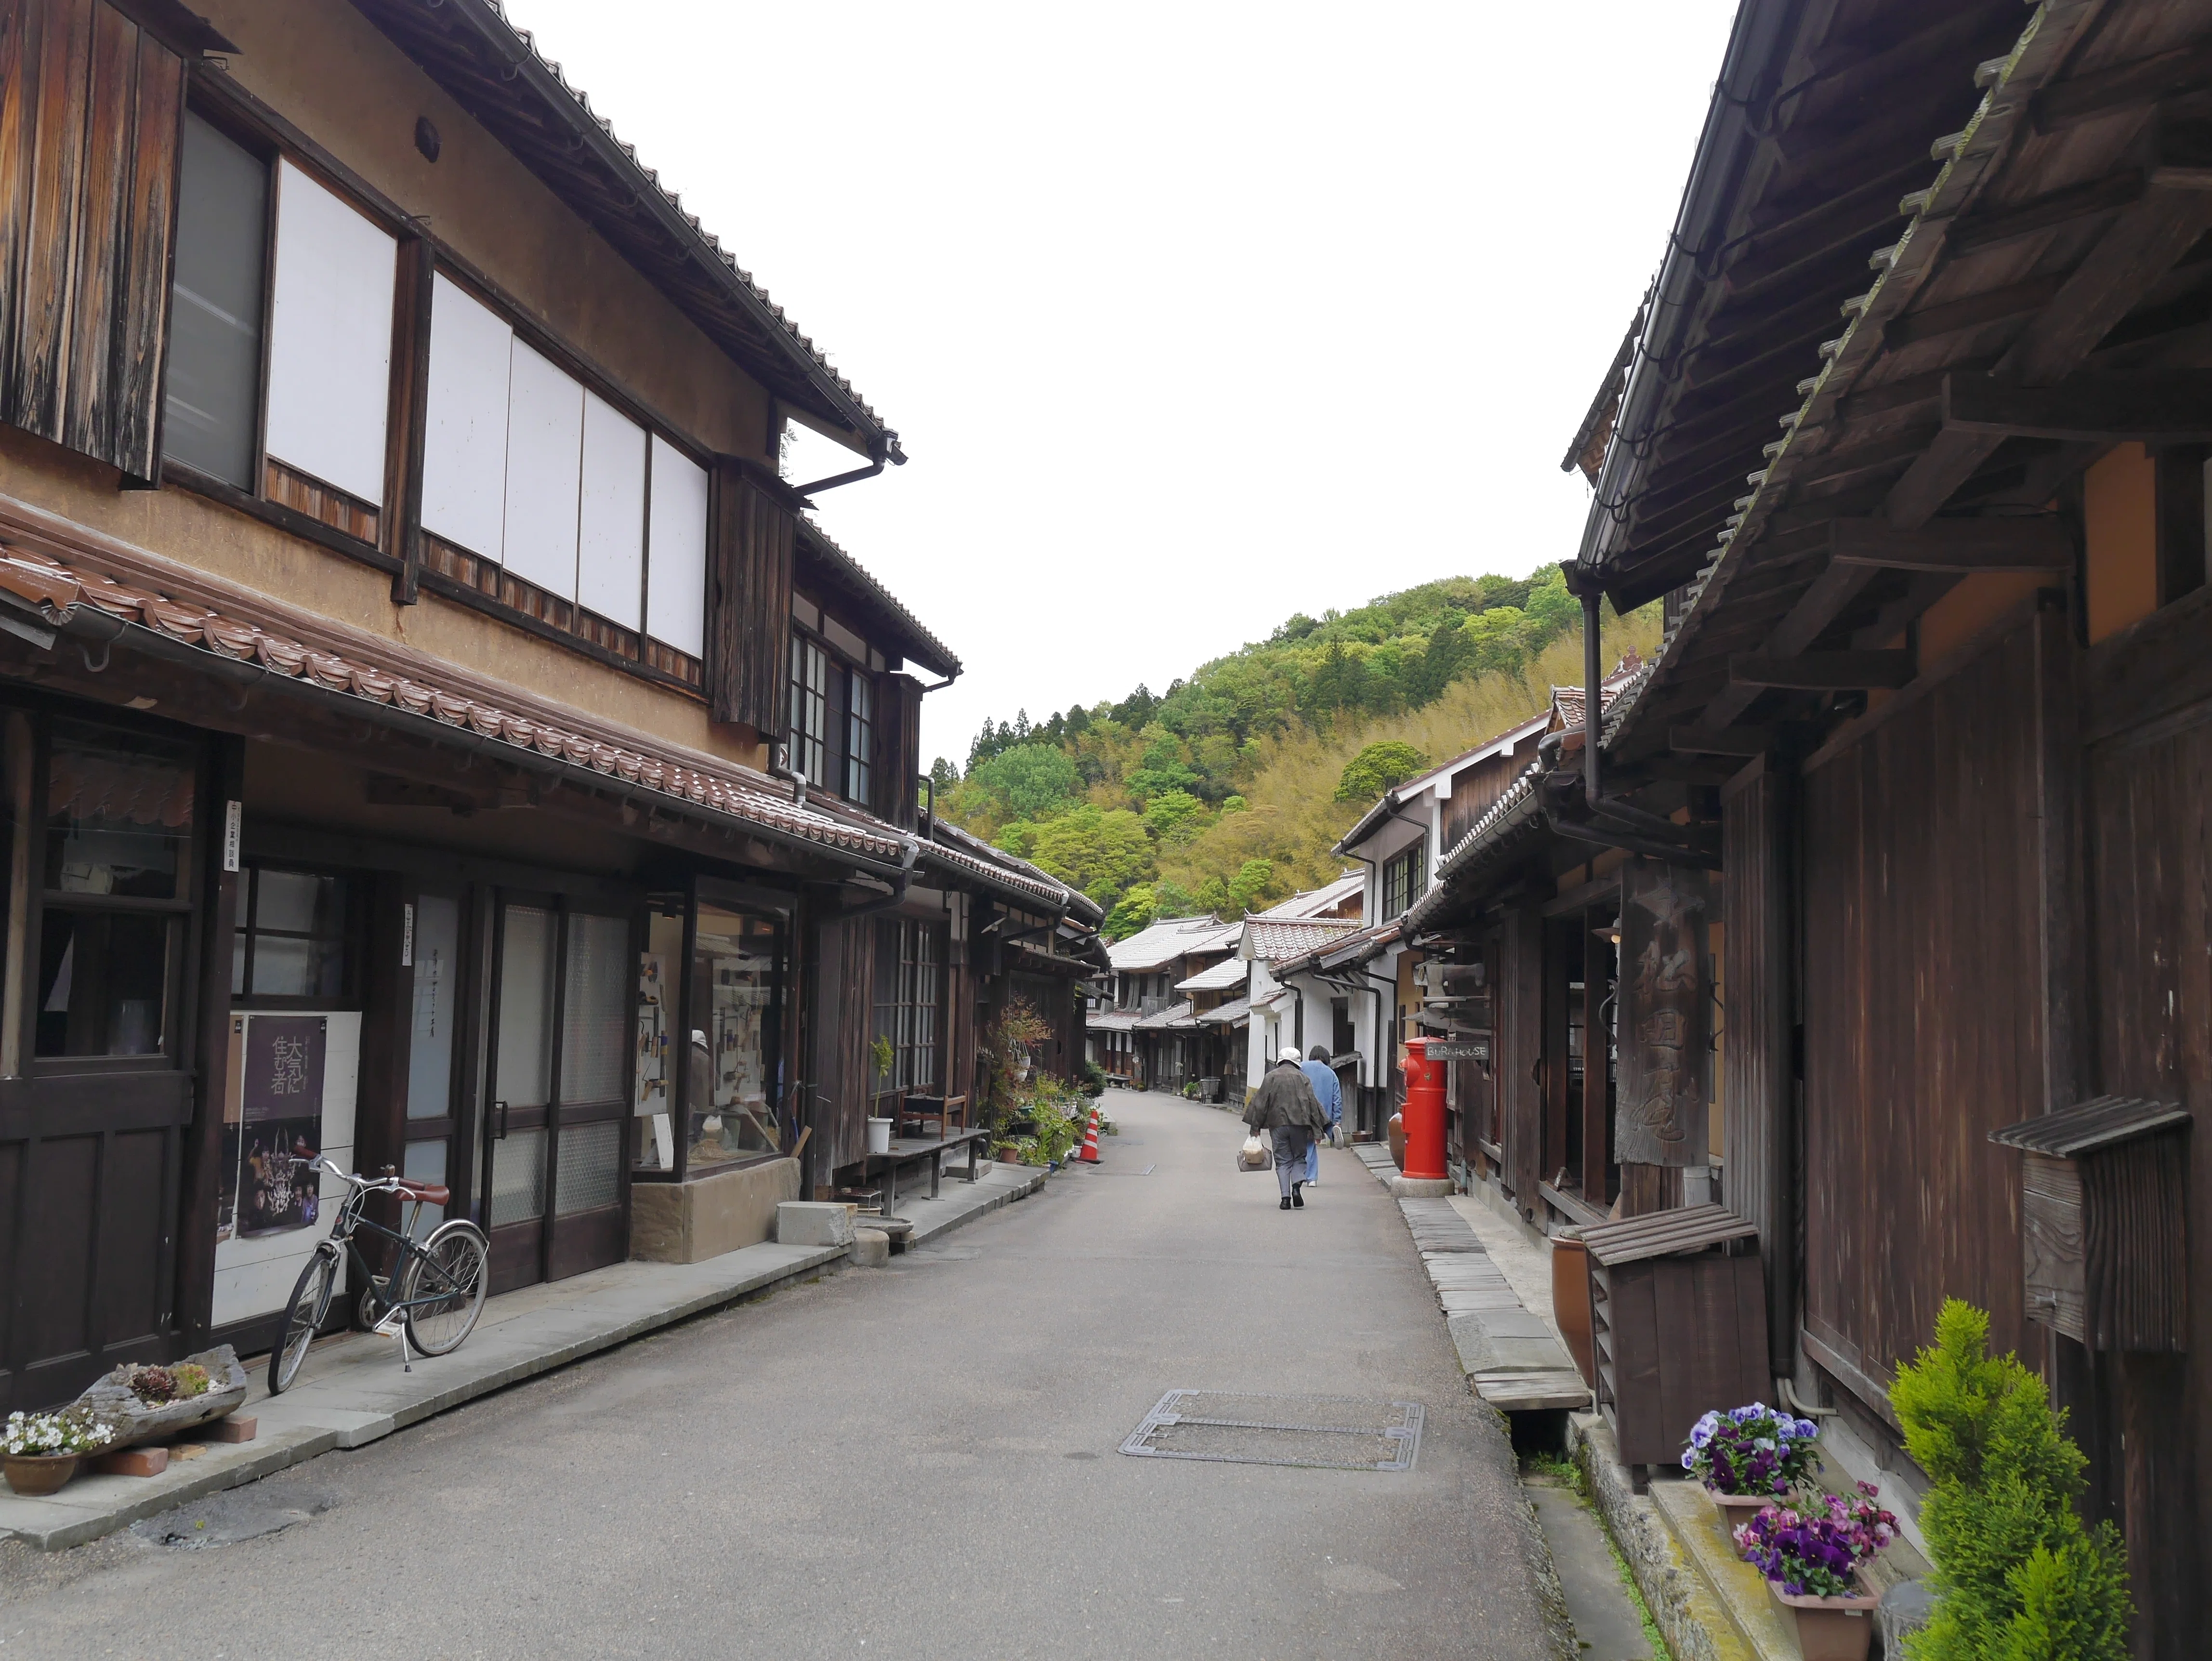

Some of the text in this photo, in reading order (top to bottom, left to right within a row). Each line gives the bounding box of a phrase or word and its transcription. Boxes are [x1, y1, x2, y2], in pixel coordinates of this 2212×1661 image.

[271, 1036, 287, 1094] 住む者
[287, 1036, 303, 1094] 大気に
[1455, 1046, 1487, 1056] HOUSE
